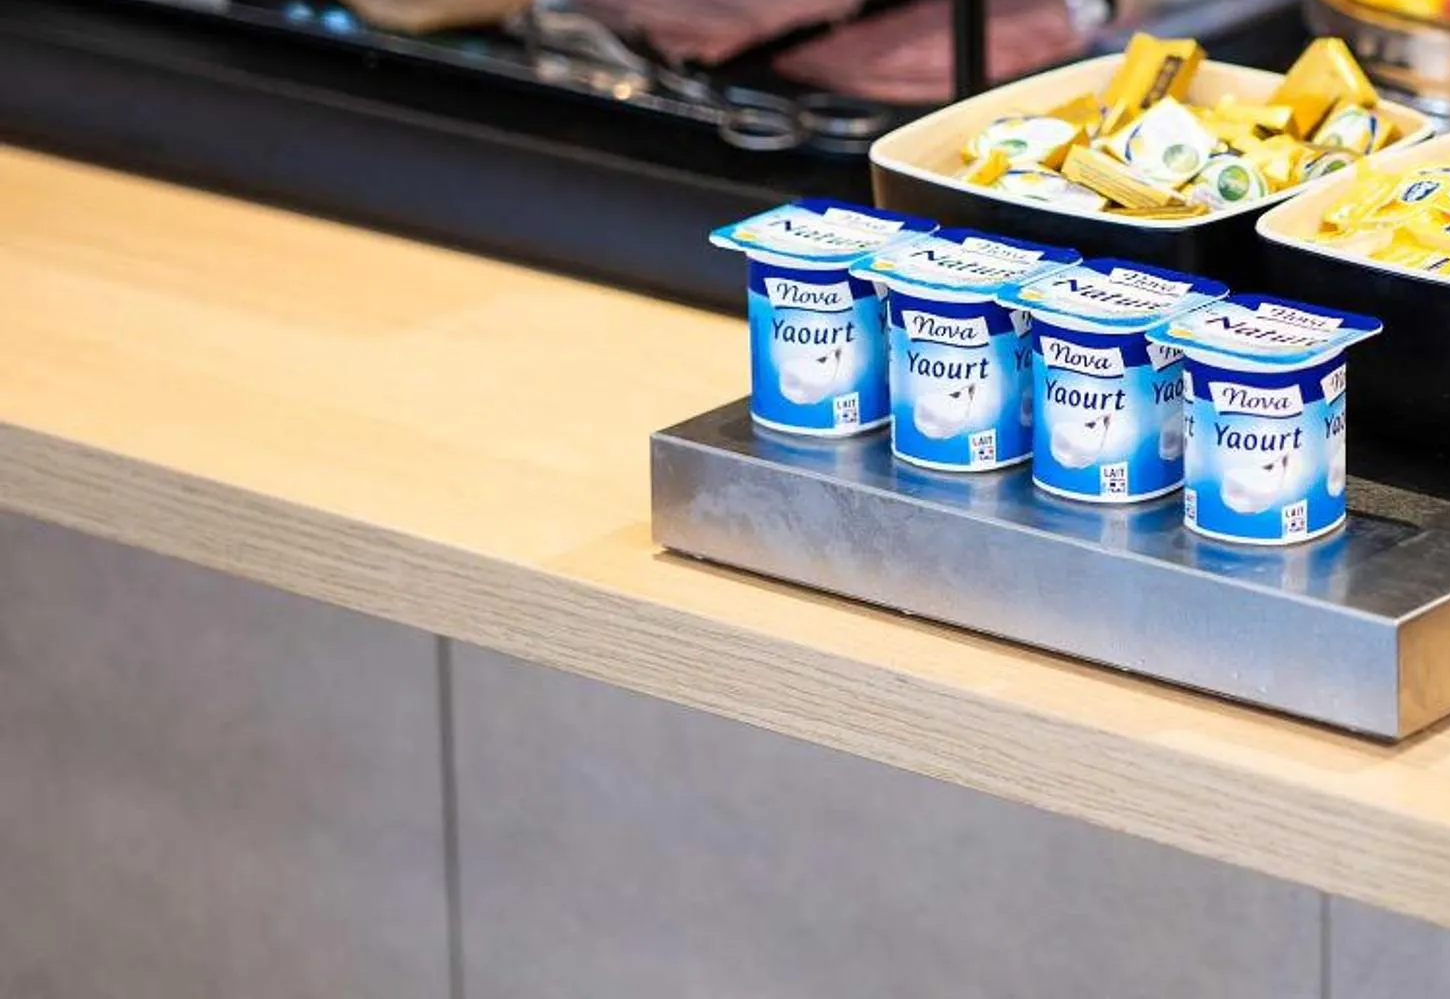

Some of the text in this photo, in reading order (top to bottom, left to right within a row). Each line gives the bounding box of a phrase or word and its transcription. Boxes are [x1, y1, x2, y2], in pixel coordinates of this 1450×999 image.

[776, 282, 842, 305] Nova
[771, 318, 854, 345] Yaourt
[912, 315, 979, 340] Nova
[907, 351, 989, 379] Yaourt
[1050, 342, 1112, 370] Nova
[1045, 379, 1126, 410] Yaourt
[1153, 380, 1183, 404] Yao
[1222, 387, 1291, 410] Nova
[1214, 423, 1303, 450] Yaourt
